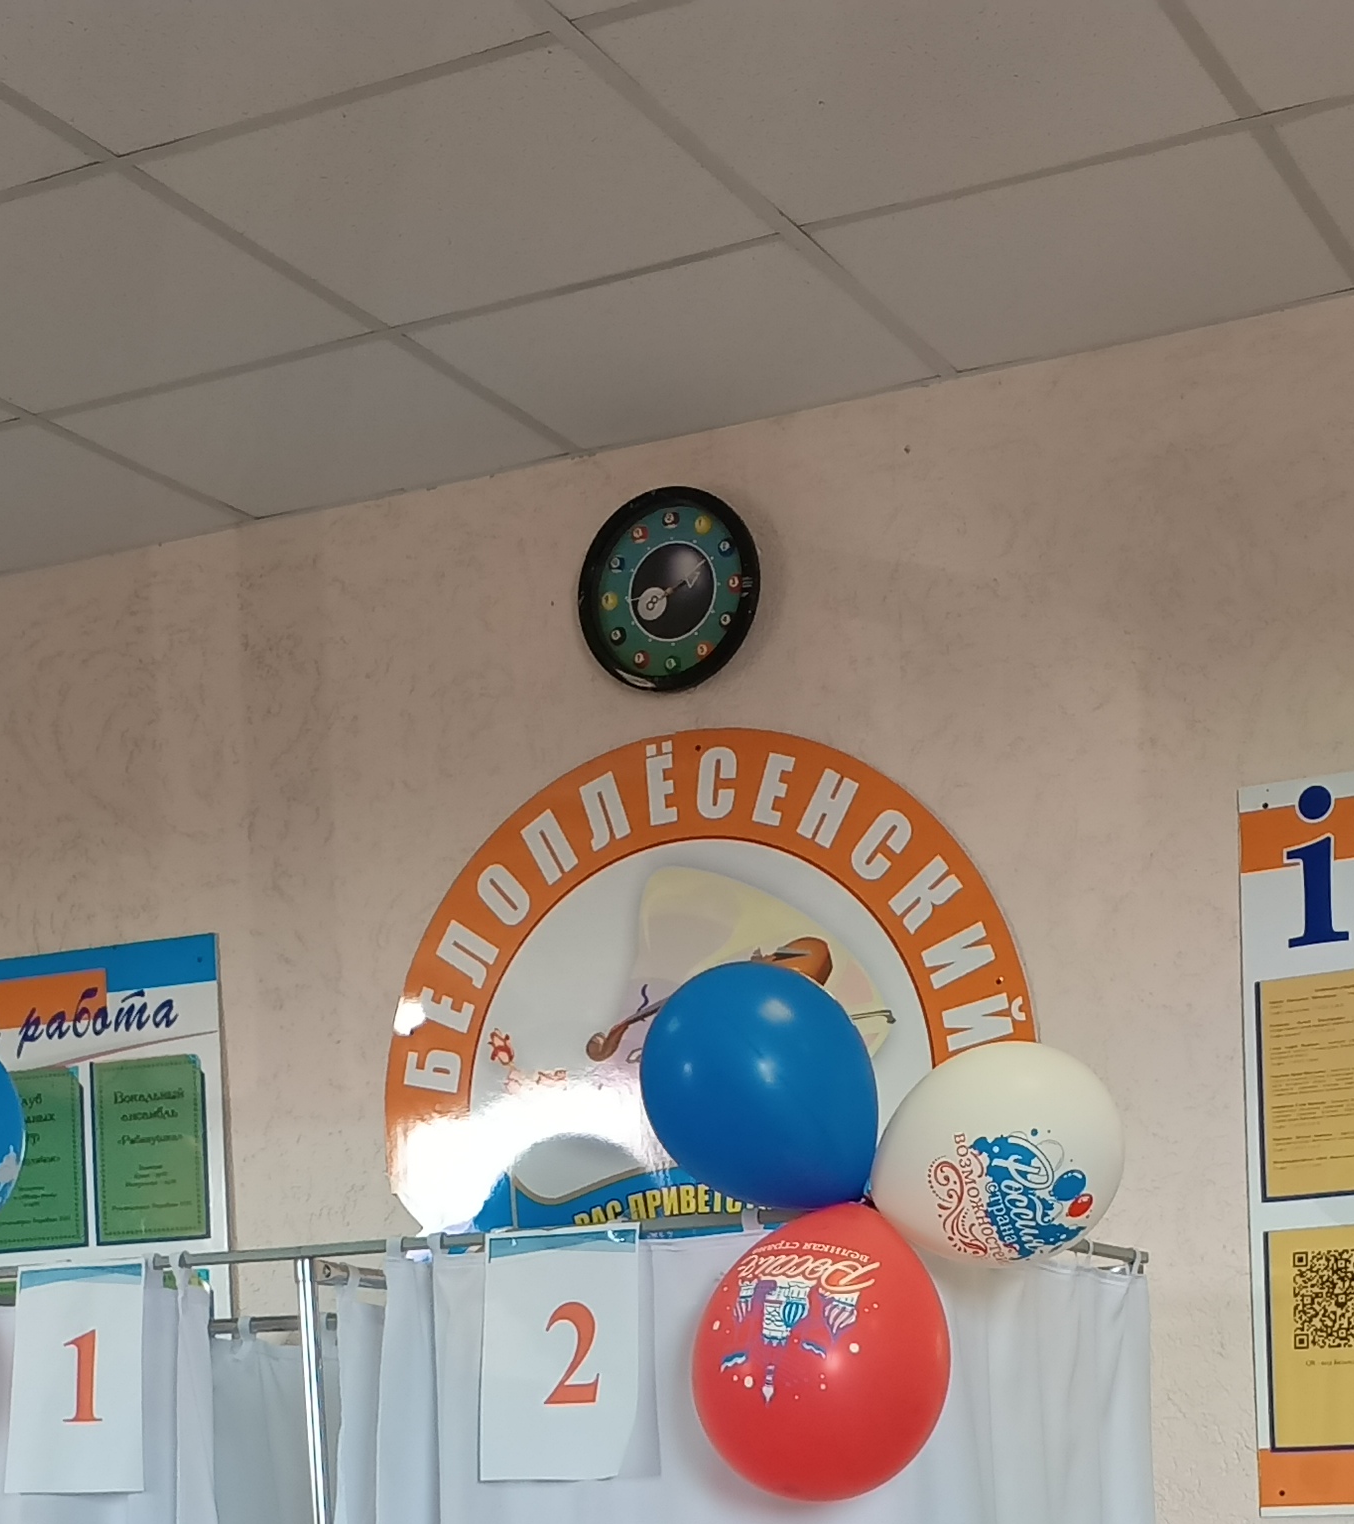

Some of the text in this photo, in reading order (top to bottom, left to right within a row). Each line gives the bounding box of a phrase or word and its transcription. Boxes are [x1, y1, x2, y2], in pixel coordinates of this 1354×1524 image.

[404, 740, 1029, 1095] БЕЛОПЛЁСЕНСКИЙ
[17, 987, 179, 1059] работа
[985, 1182, 1018, 1245] страна
[991, 1135, 1055, 1253] Россия
[802, 1242, 870, 1263] великая
[62, 1328, 103, 1423] 1
[544, 1301, 601, 1405] 2
